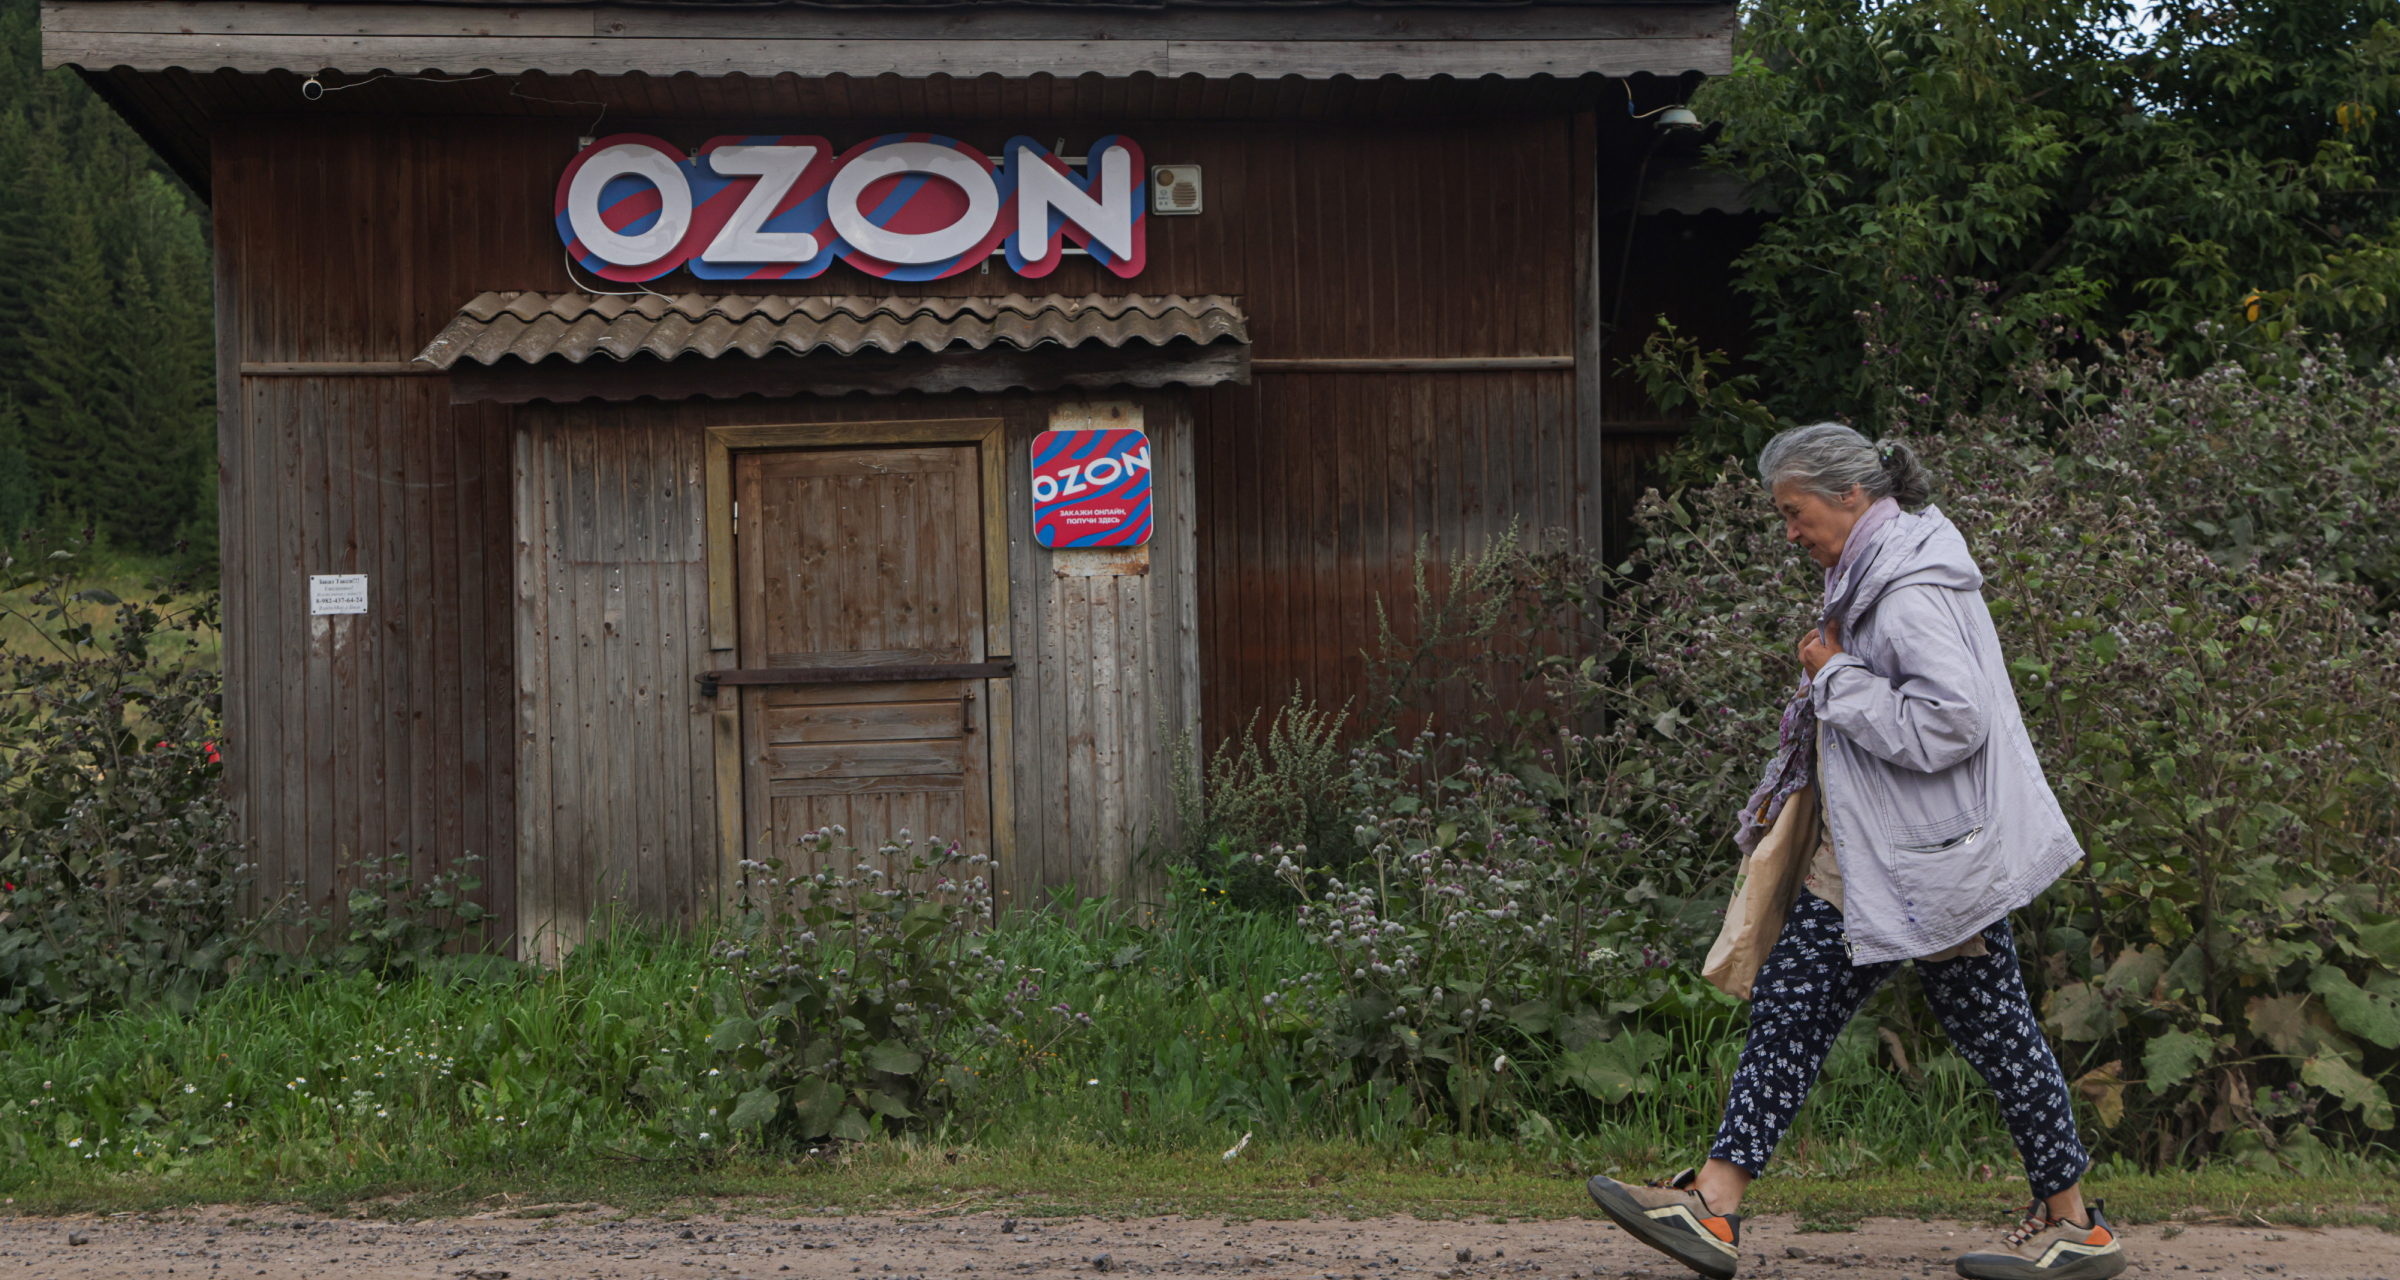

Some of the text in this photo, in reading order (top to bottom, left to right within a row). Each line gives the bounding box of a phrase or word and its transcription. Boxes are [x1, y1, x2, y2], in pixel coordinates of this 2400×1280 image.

[567, 141, 1132, 266] OZON
[1033, 446, 1150, 502] OZON
[1060, 507, 1127, 517] ЗАКАЖИ ОНЛАЙН,
[1066, 516, 1121, 525] ПОЛУЧИ ЗДЕСЬ
